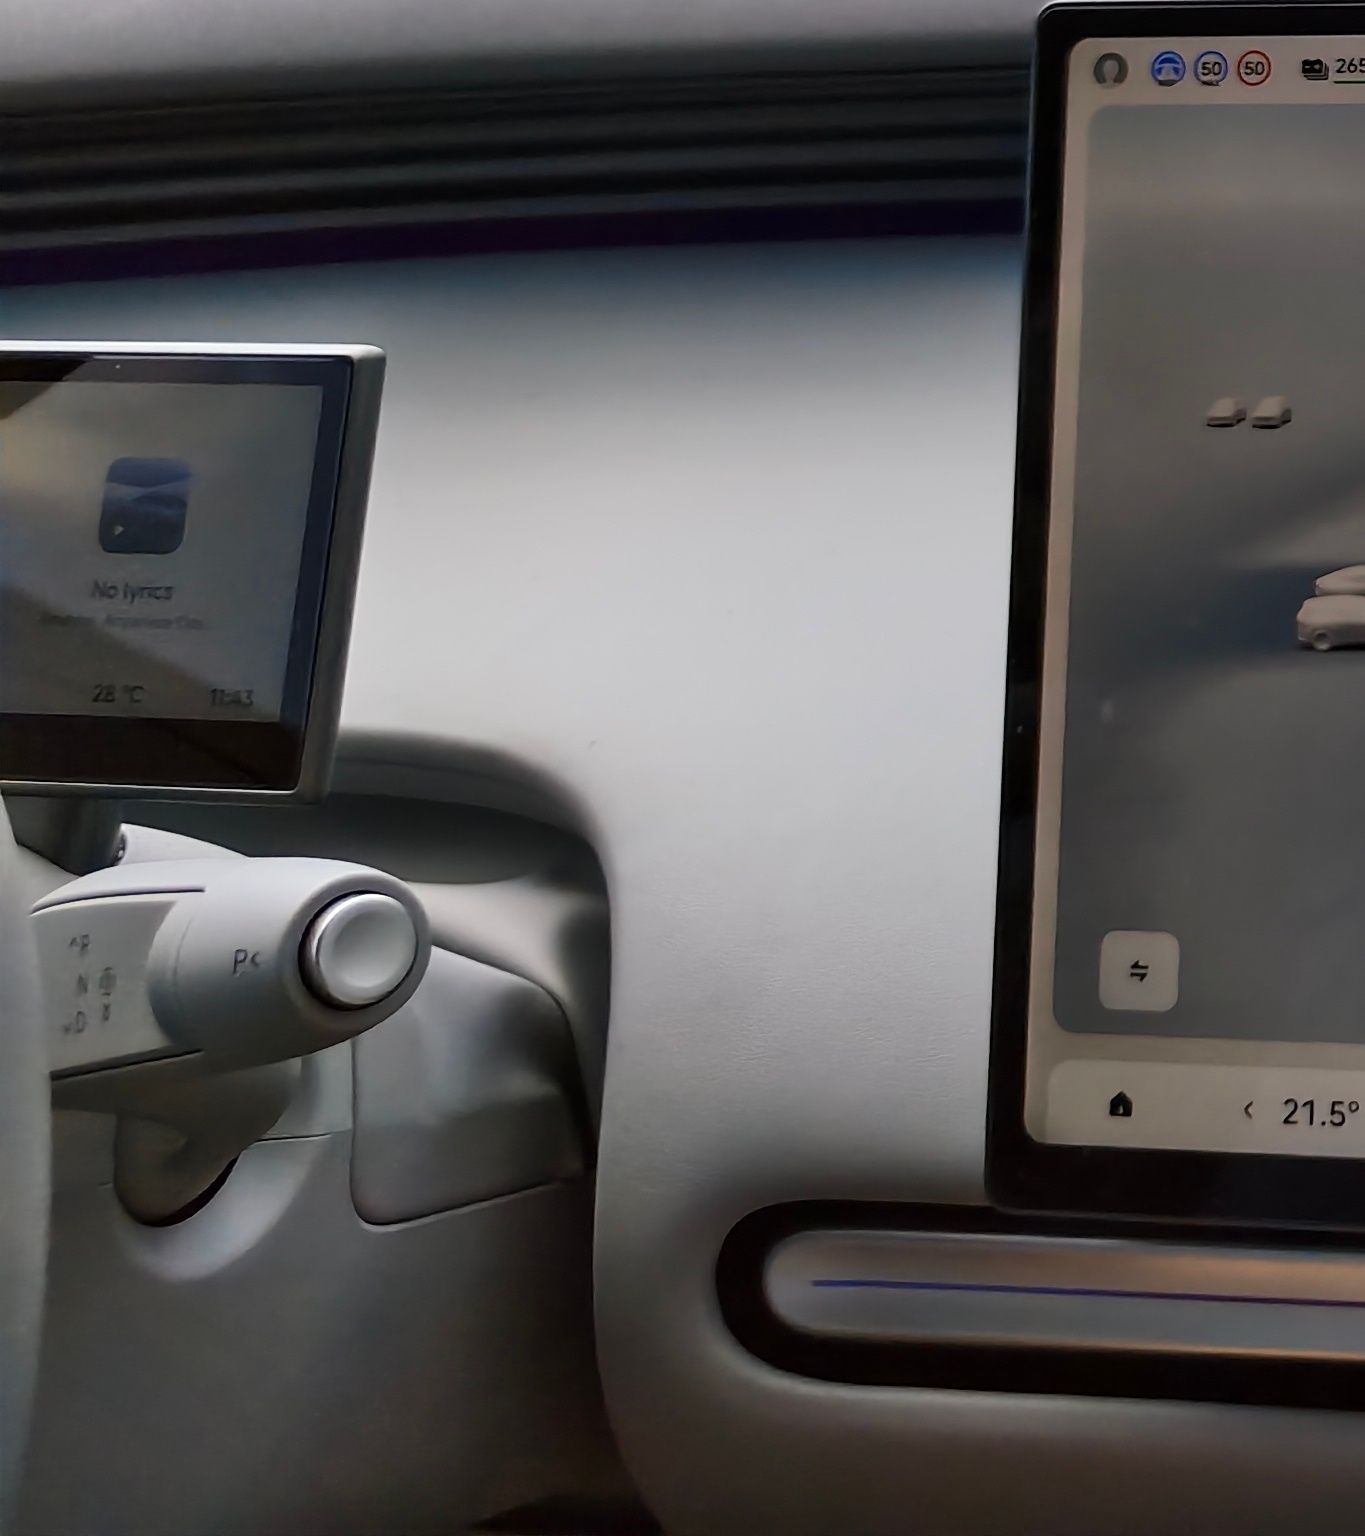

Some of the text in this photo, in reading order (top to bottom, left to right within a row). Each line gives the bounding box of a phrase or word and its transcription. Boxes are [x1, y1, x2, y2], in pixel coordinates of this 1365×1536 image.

[1201, 61, 1222, 77] 50
[1243, 60, 1266, 77] 50
[91, 580, 117, 600] No
[1282, 1097, 1360, 1127] 21.5°
